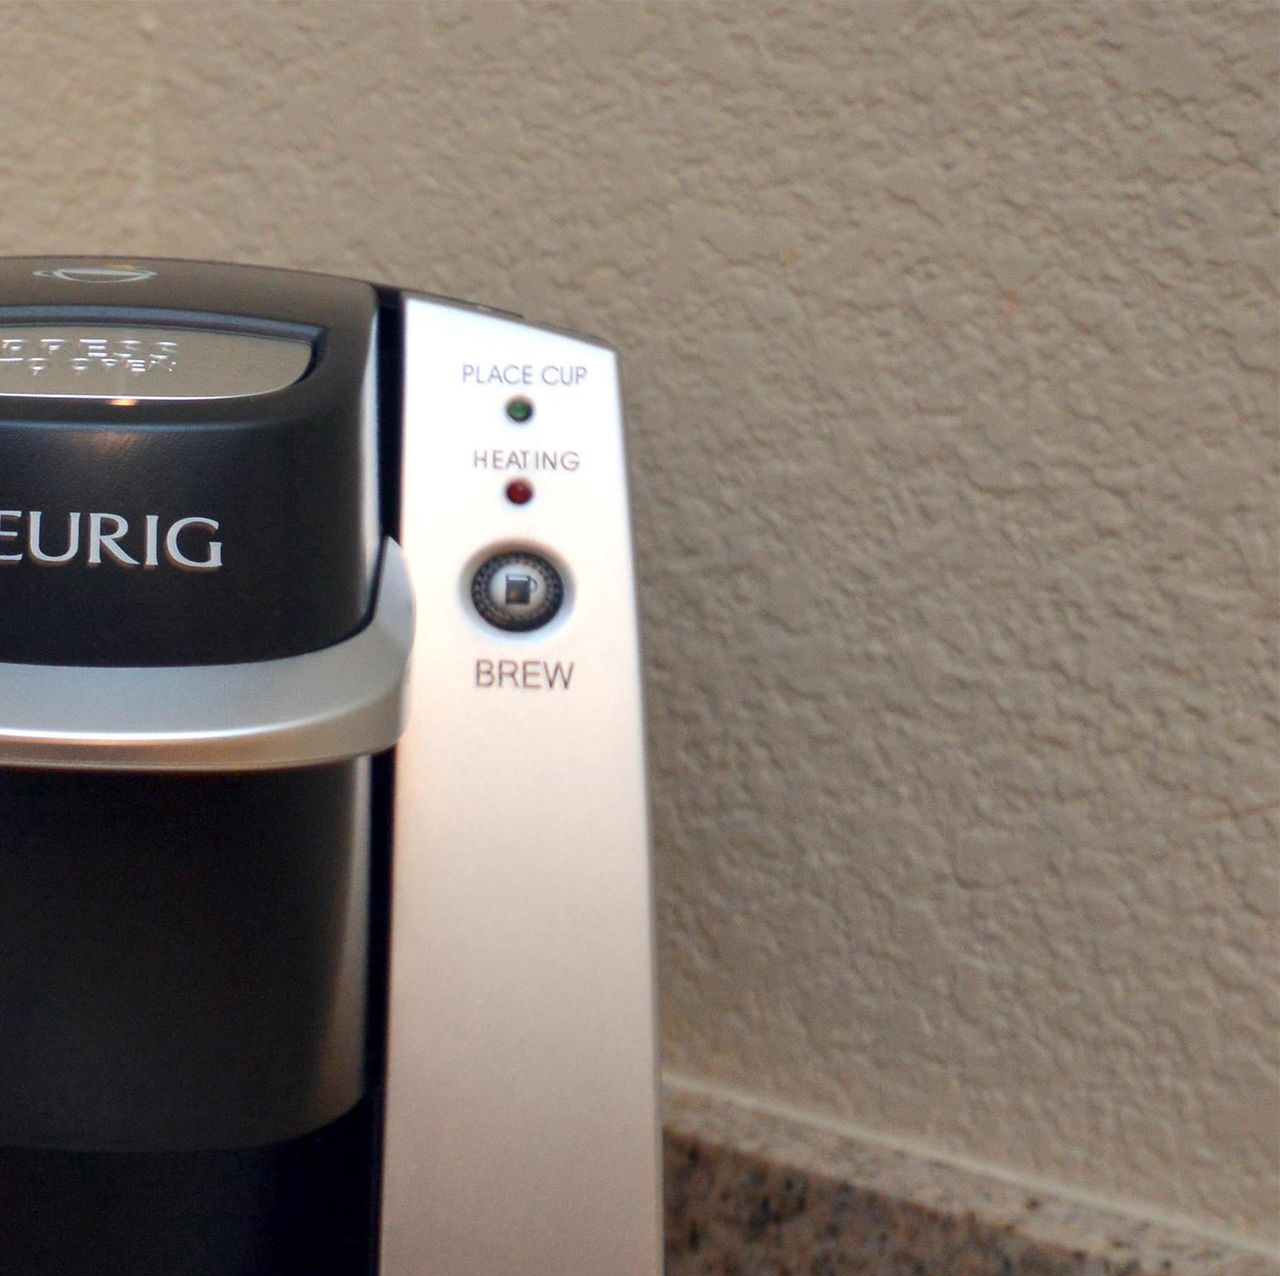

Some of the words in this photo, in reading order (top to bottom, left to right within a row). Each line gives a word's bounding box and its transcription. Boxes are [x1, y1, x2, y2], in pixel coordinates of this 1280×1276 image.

[461, 364, 534, 385] PLACE
[541, 365, 588, 387] CUP
[473, 450, 581, 471] HEATING
[474, 659, 576, 690] BREW
